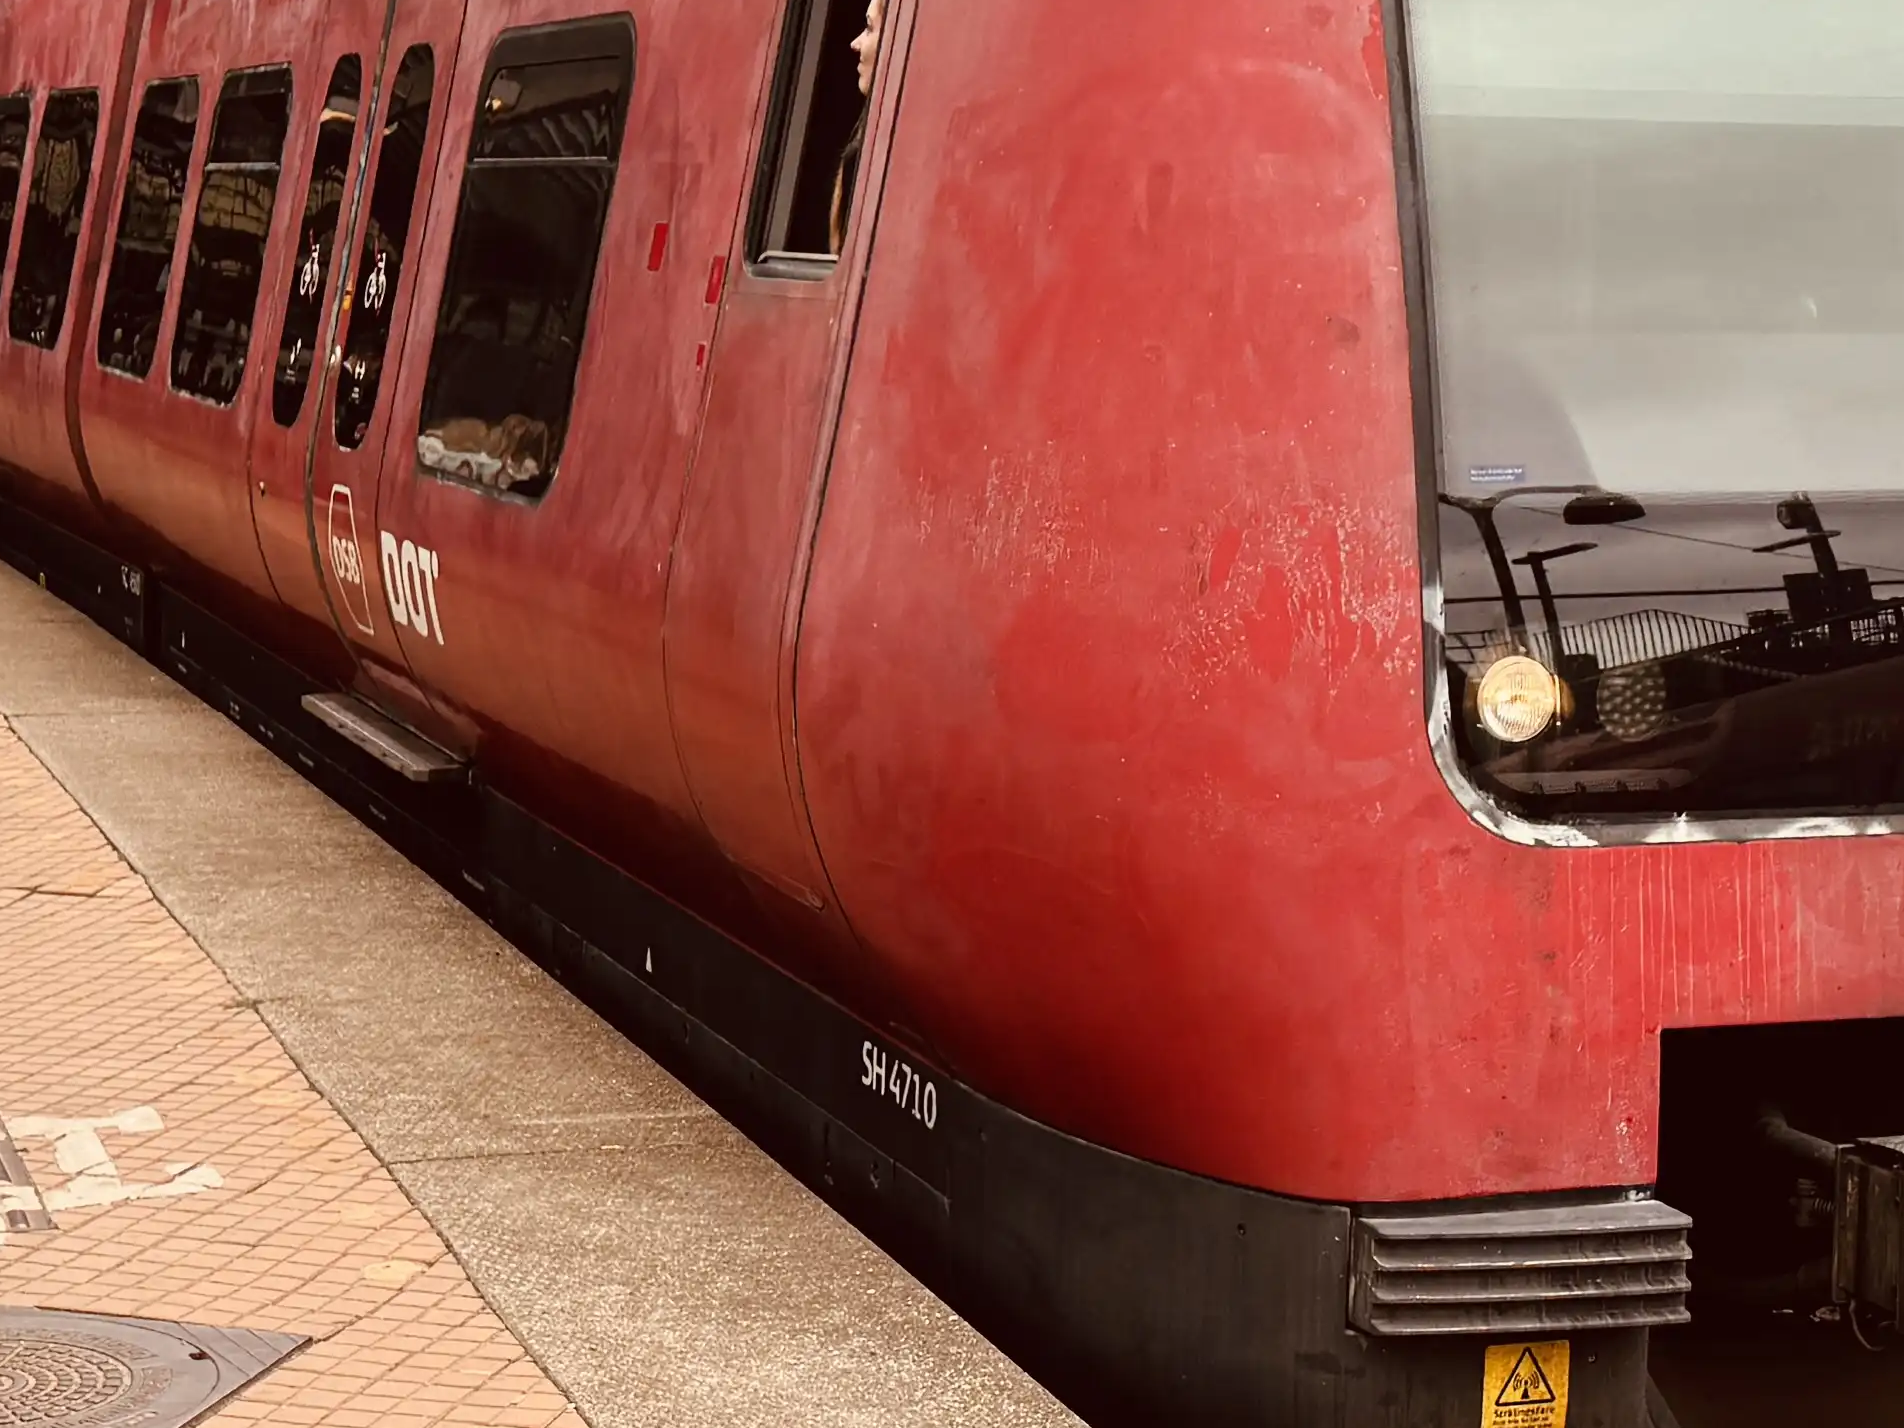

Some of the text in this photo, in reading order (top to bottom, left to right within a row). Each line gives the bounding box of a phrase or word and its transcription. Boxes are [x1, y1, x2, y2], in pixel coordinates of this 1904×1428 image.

[331, 535, 361, 585] DSB
[861, 1040, 937, 1130] SH 4710
